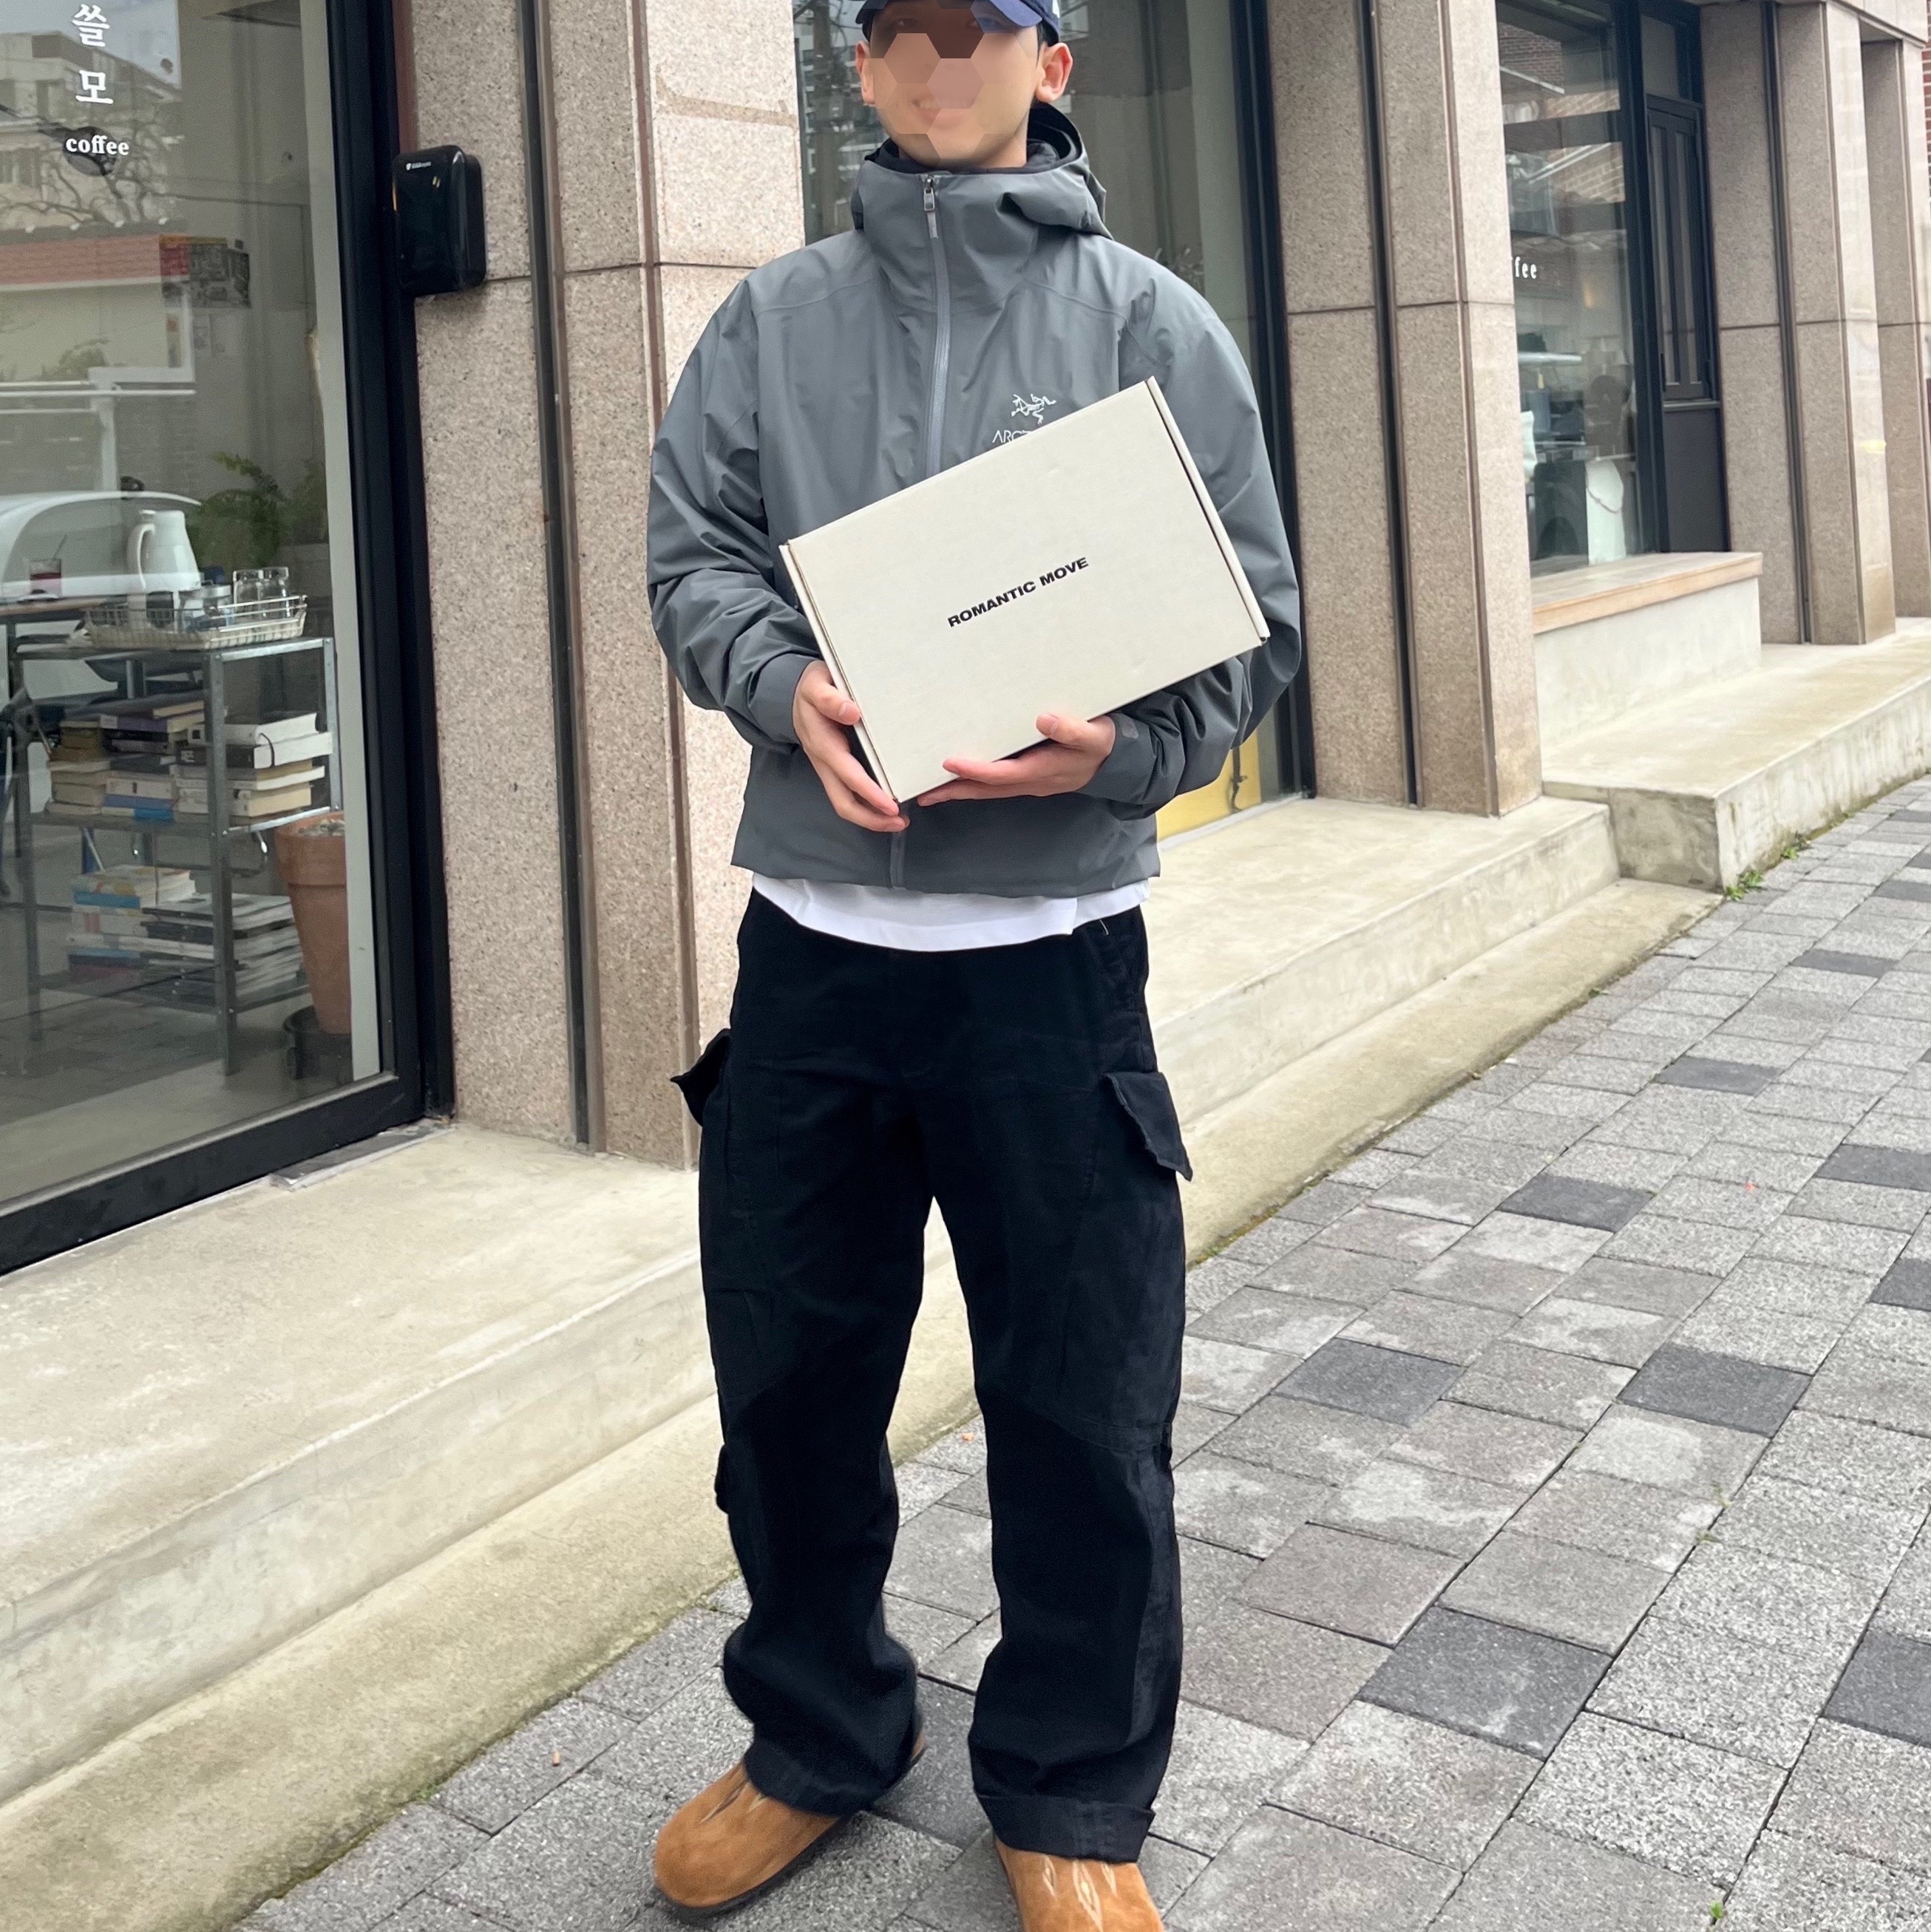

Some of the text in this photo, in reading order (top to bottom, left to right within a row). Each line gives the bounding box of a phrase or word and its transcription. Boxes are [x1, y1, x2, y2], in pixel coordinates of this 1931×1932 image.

[66, 135, 129, 155] coffee
[1511, 256, 1537, 279] fee
[947, 557, 1089, 627] ROMANTIC MOVE
